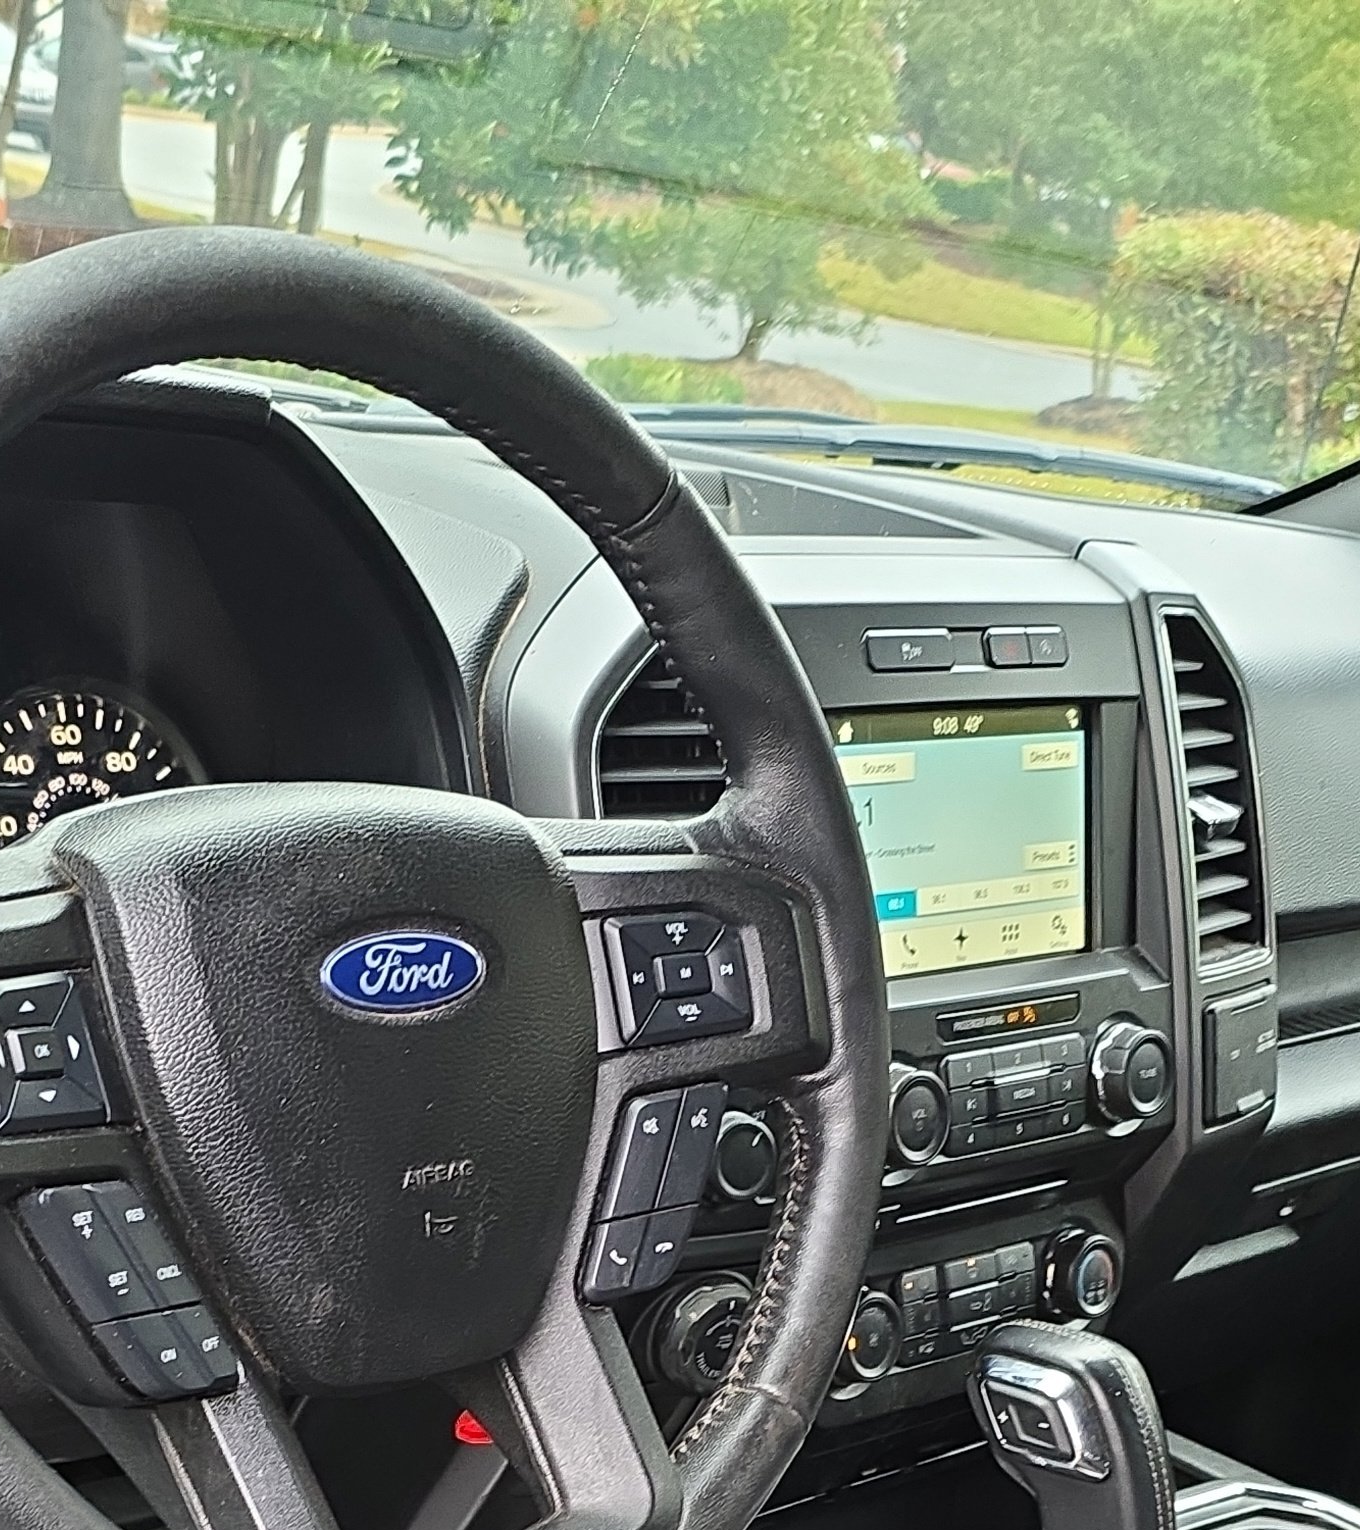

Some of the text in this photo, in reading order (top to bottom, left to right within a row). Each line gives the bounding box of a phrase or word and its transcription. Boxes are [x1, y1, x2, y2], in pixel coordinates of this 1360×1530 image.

[50, 724, 82, 746] 60
[2, 754, 35, 776] 40
[56, 750, 85, 766] MPH
[105, 751, 137, 773] 80
[665, 921, 689, 935] VOL
[358, 941, 454, 995] Ford
[677, 1003, 702, 1017] VOL
[33, 1043, 51, 1060] OK
[966, 1131, 976, 1145] 4
[696, 1351, 722, 1379] TRAILE
